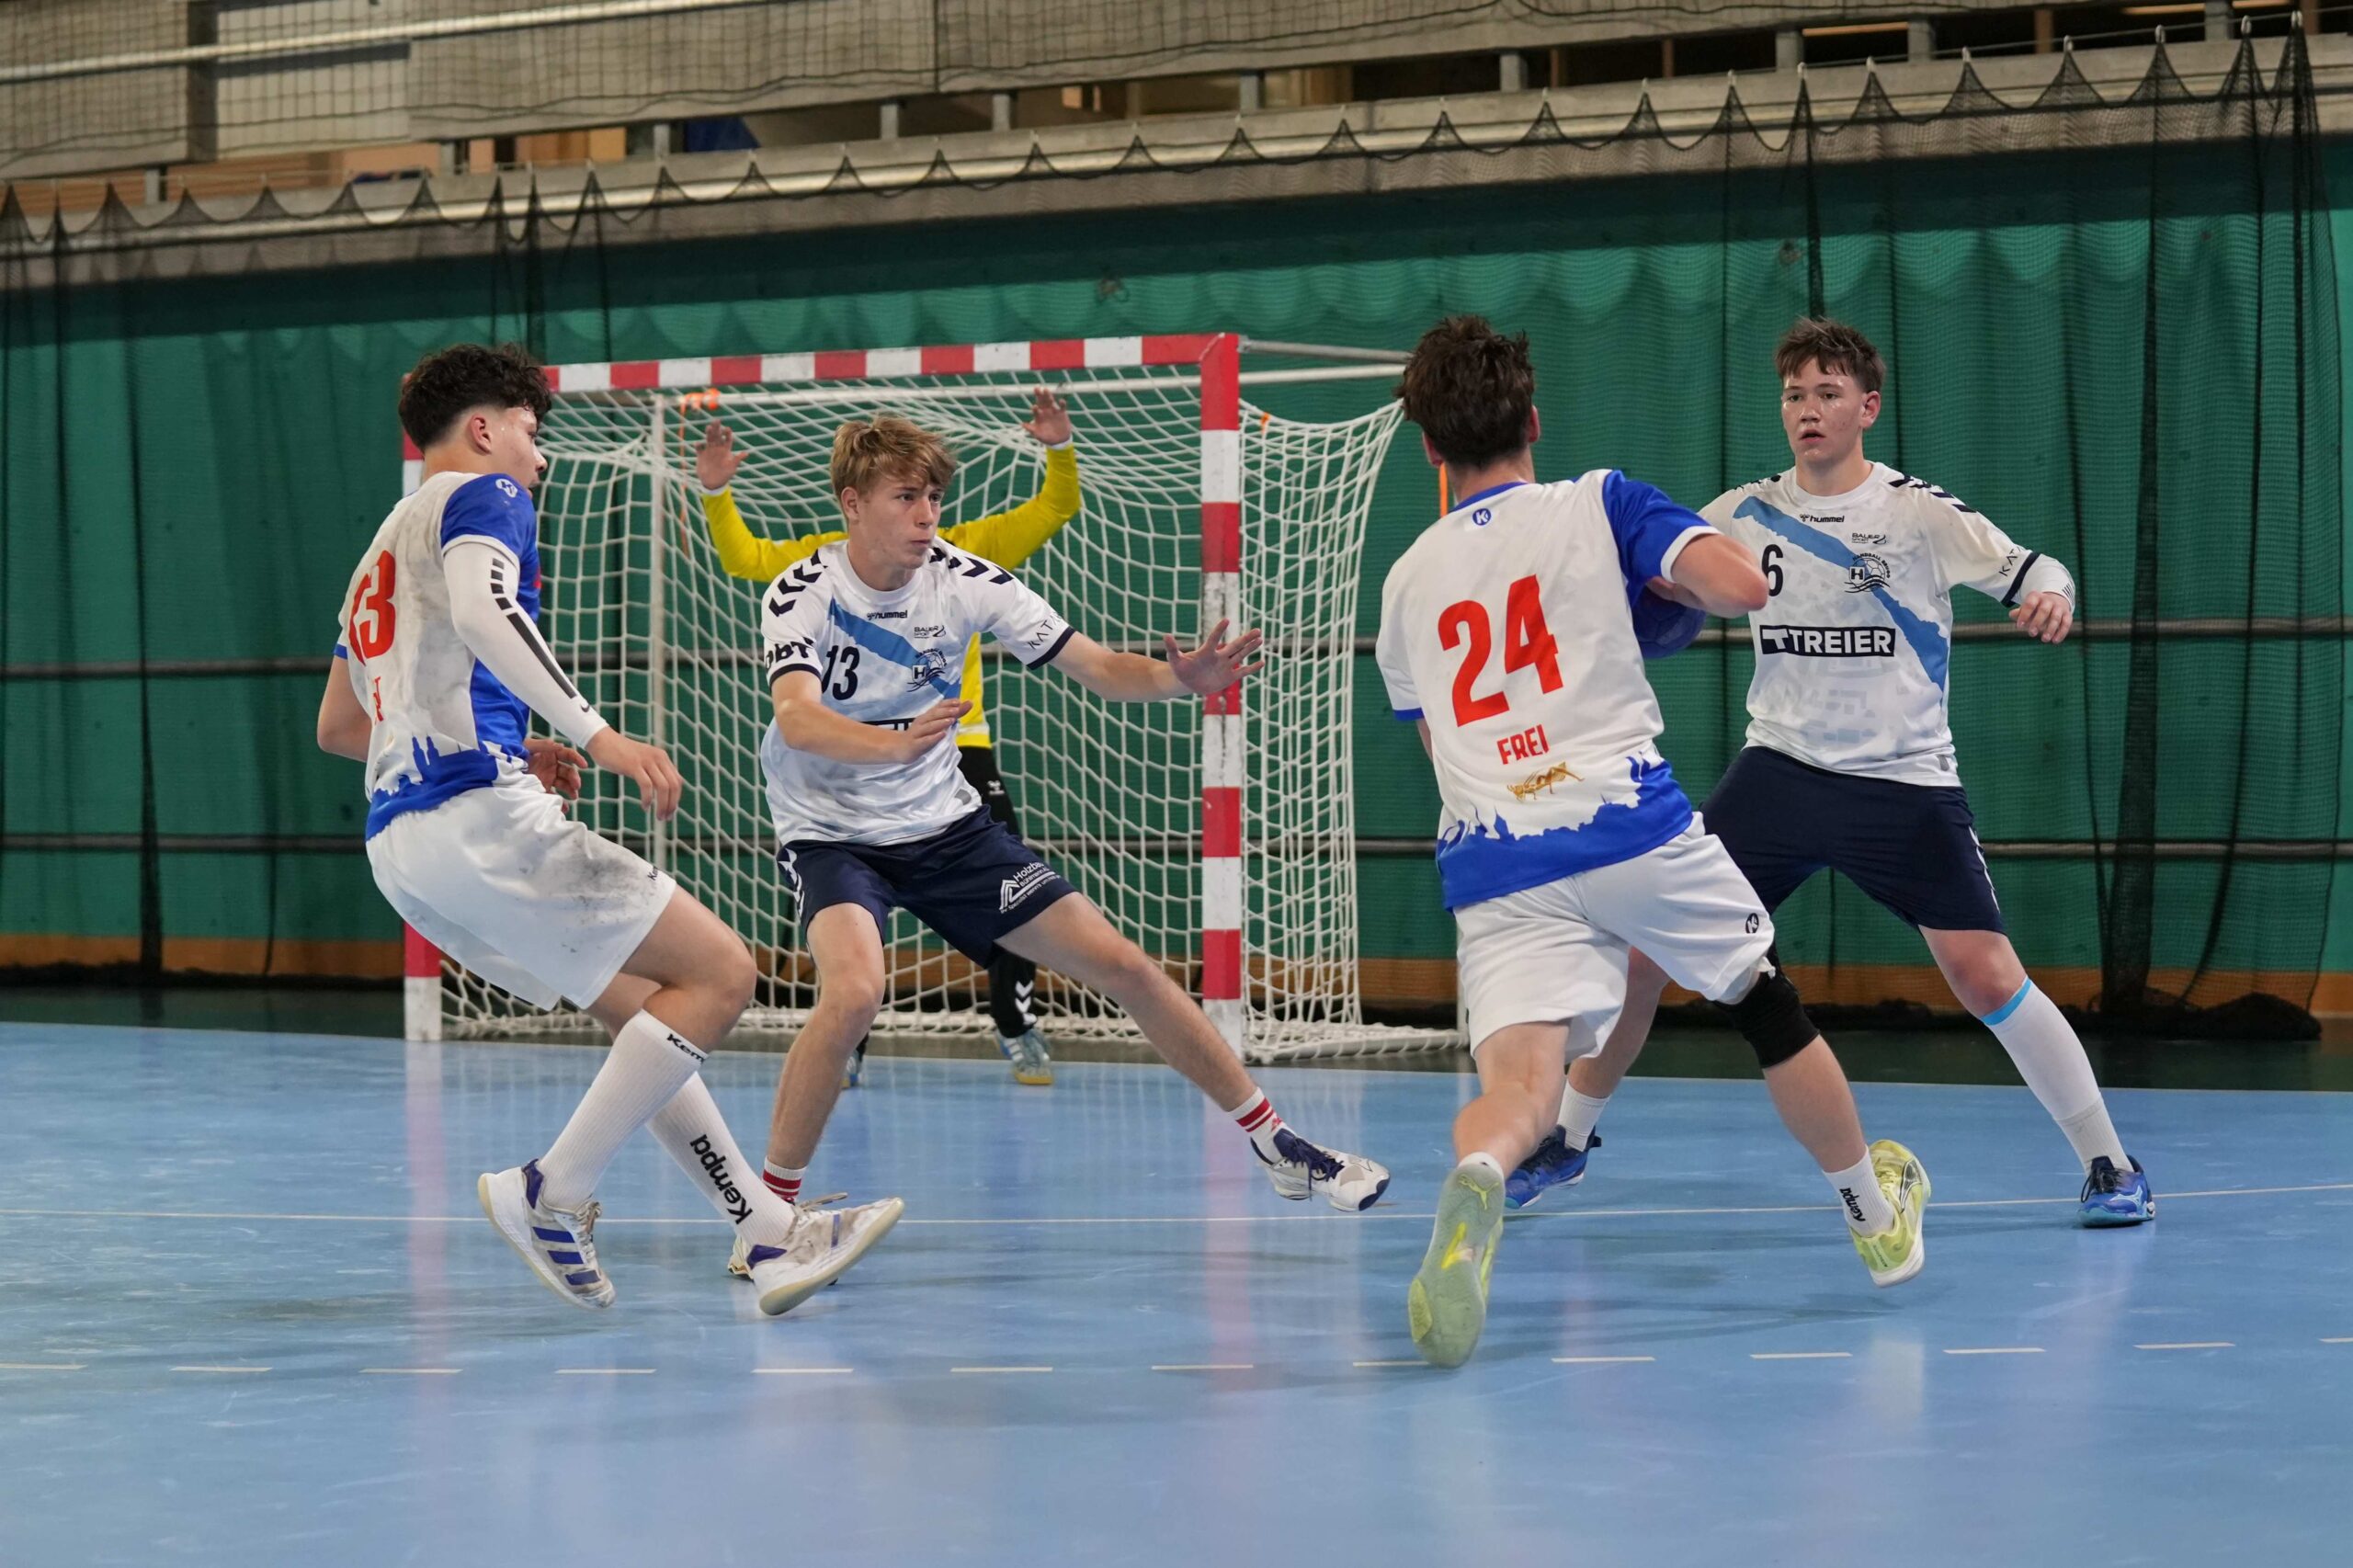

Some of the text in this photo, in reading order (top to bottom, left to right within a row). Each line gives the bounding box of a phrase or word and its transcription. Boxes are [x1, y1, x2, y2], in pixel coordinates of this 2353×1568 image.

[1762, 544, 1783, 597] 6
[1851, 568, 1864, 580] H
[874, 610, 908, 619] hummel
[1438, 574, 1563, 727] 24
[1788, 629, 1892, 653] TREIER
[821, 645, 860, 701] 13
[914, 666, 926, 680] H
[1496, 724, 1550, 765] FREI
[689, 1134, 754, 1225] Kempa
[1839, 1187, 1866, 1222] Kempa
